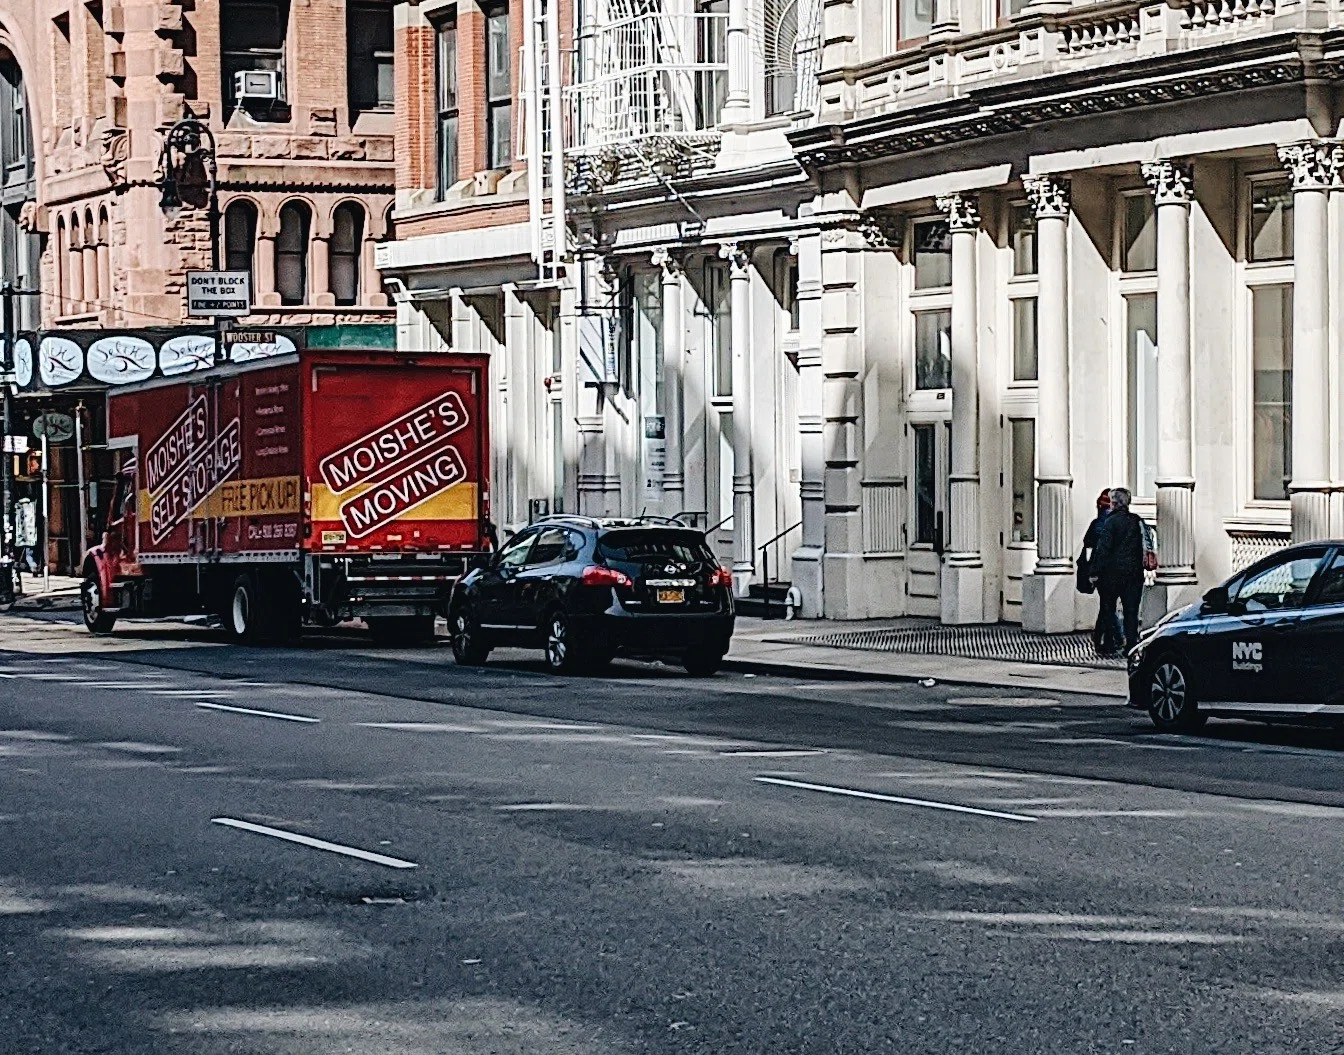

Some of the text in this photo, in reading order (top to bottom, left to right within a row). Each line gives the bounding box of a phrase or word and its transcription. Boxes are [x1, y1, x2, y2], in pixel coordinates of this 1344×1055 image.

[191, 277, 245, 285] DON'T BLOCK
[201, 286, 236, 295] THE BOX
[226, 331, 274, 343] WOOSTER ST
[148, 407, 206, 488] MOISHE'S
[328, 401, 459, 487] MOISHE'S
[152, 428, 240, 536] SELF STORAGE
[250, 482, 275, 511] PICK
[349, 455, 460, 529] MOVING
[1232, 641, 1263, 661] NYC
